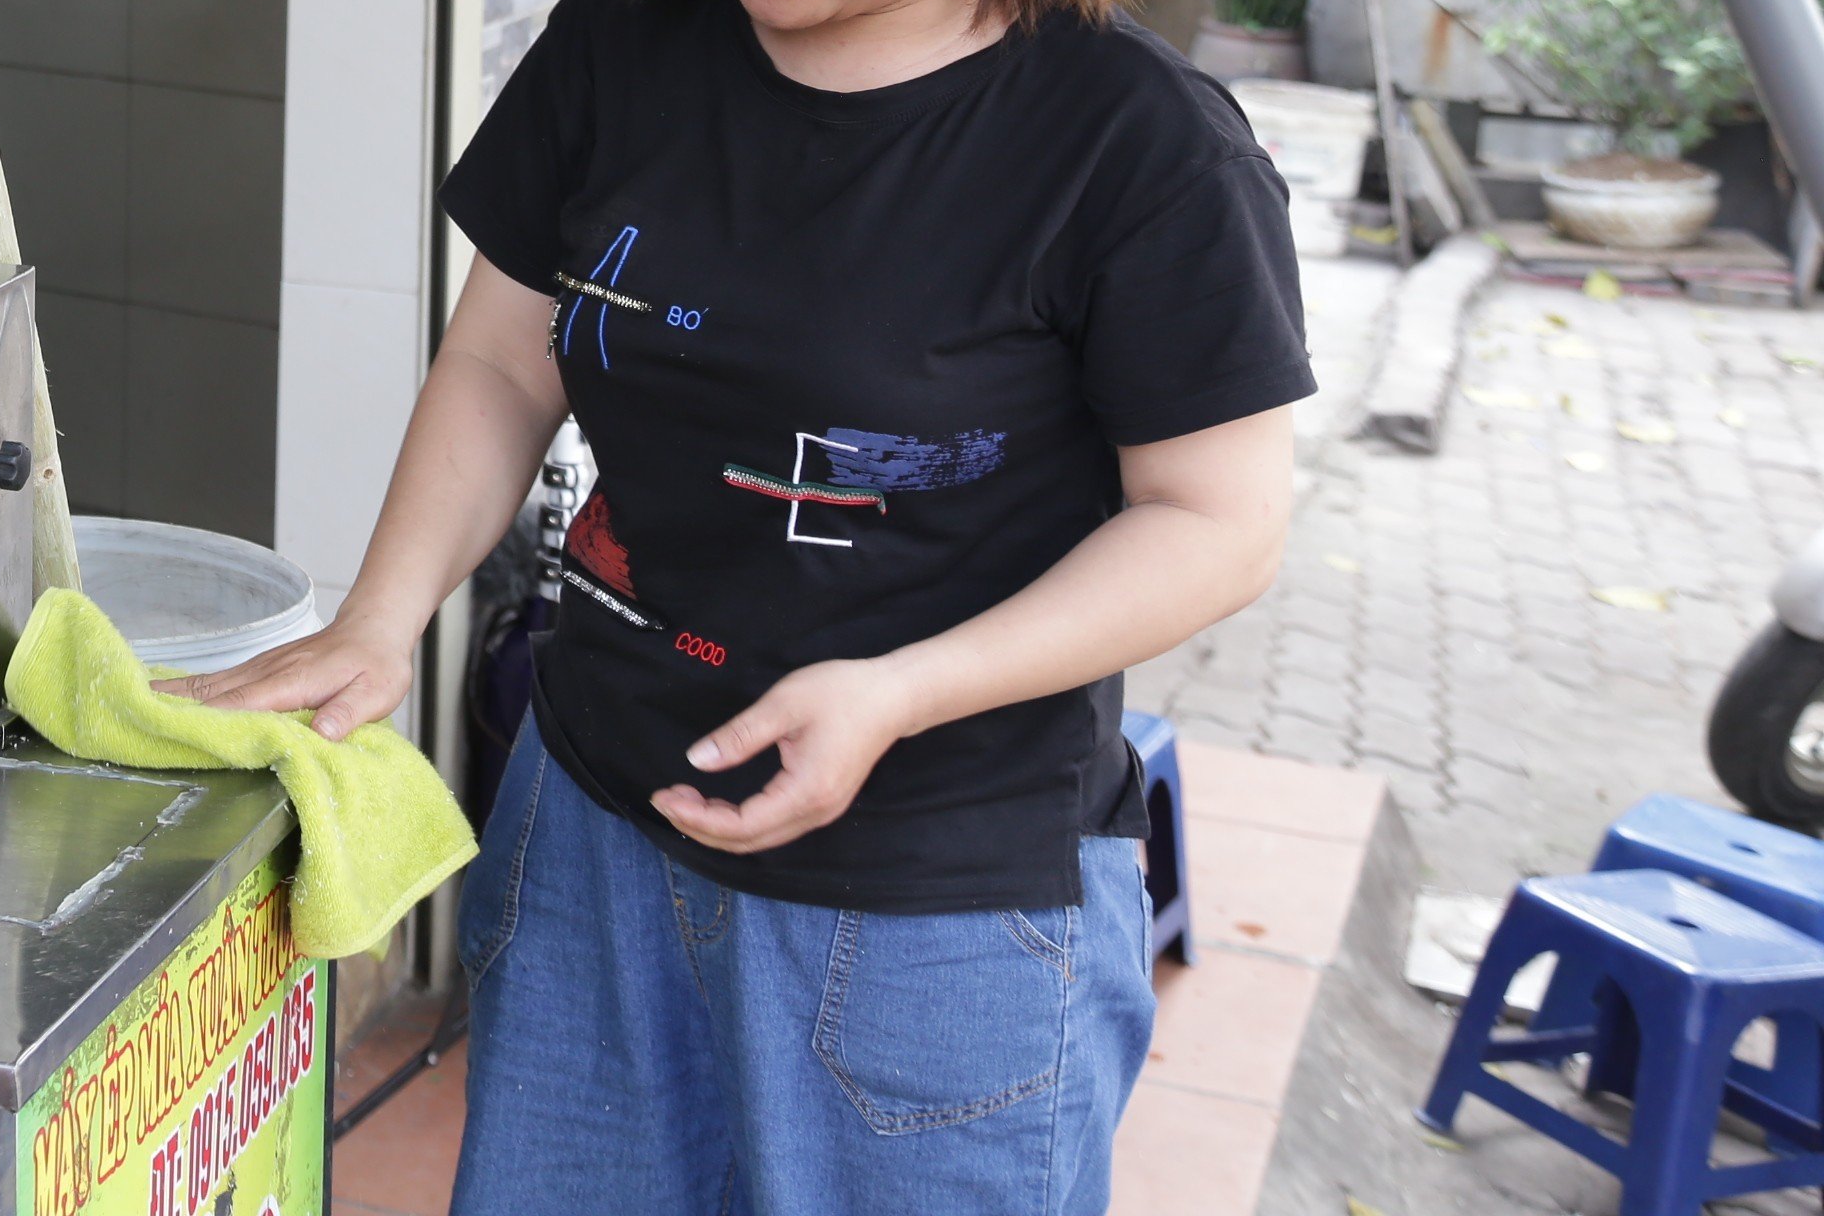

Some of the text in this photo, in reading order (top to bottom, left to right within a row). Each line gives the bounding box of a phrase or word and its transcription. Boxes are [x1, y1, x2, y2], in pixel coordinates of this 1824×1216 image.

[33, 882, 308, 1216] MÁY ÉP MÍA XUÂN THU
[187, 969, 315, 1216] 0915.059.035
